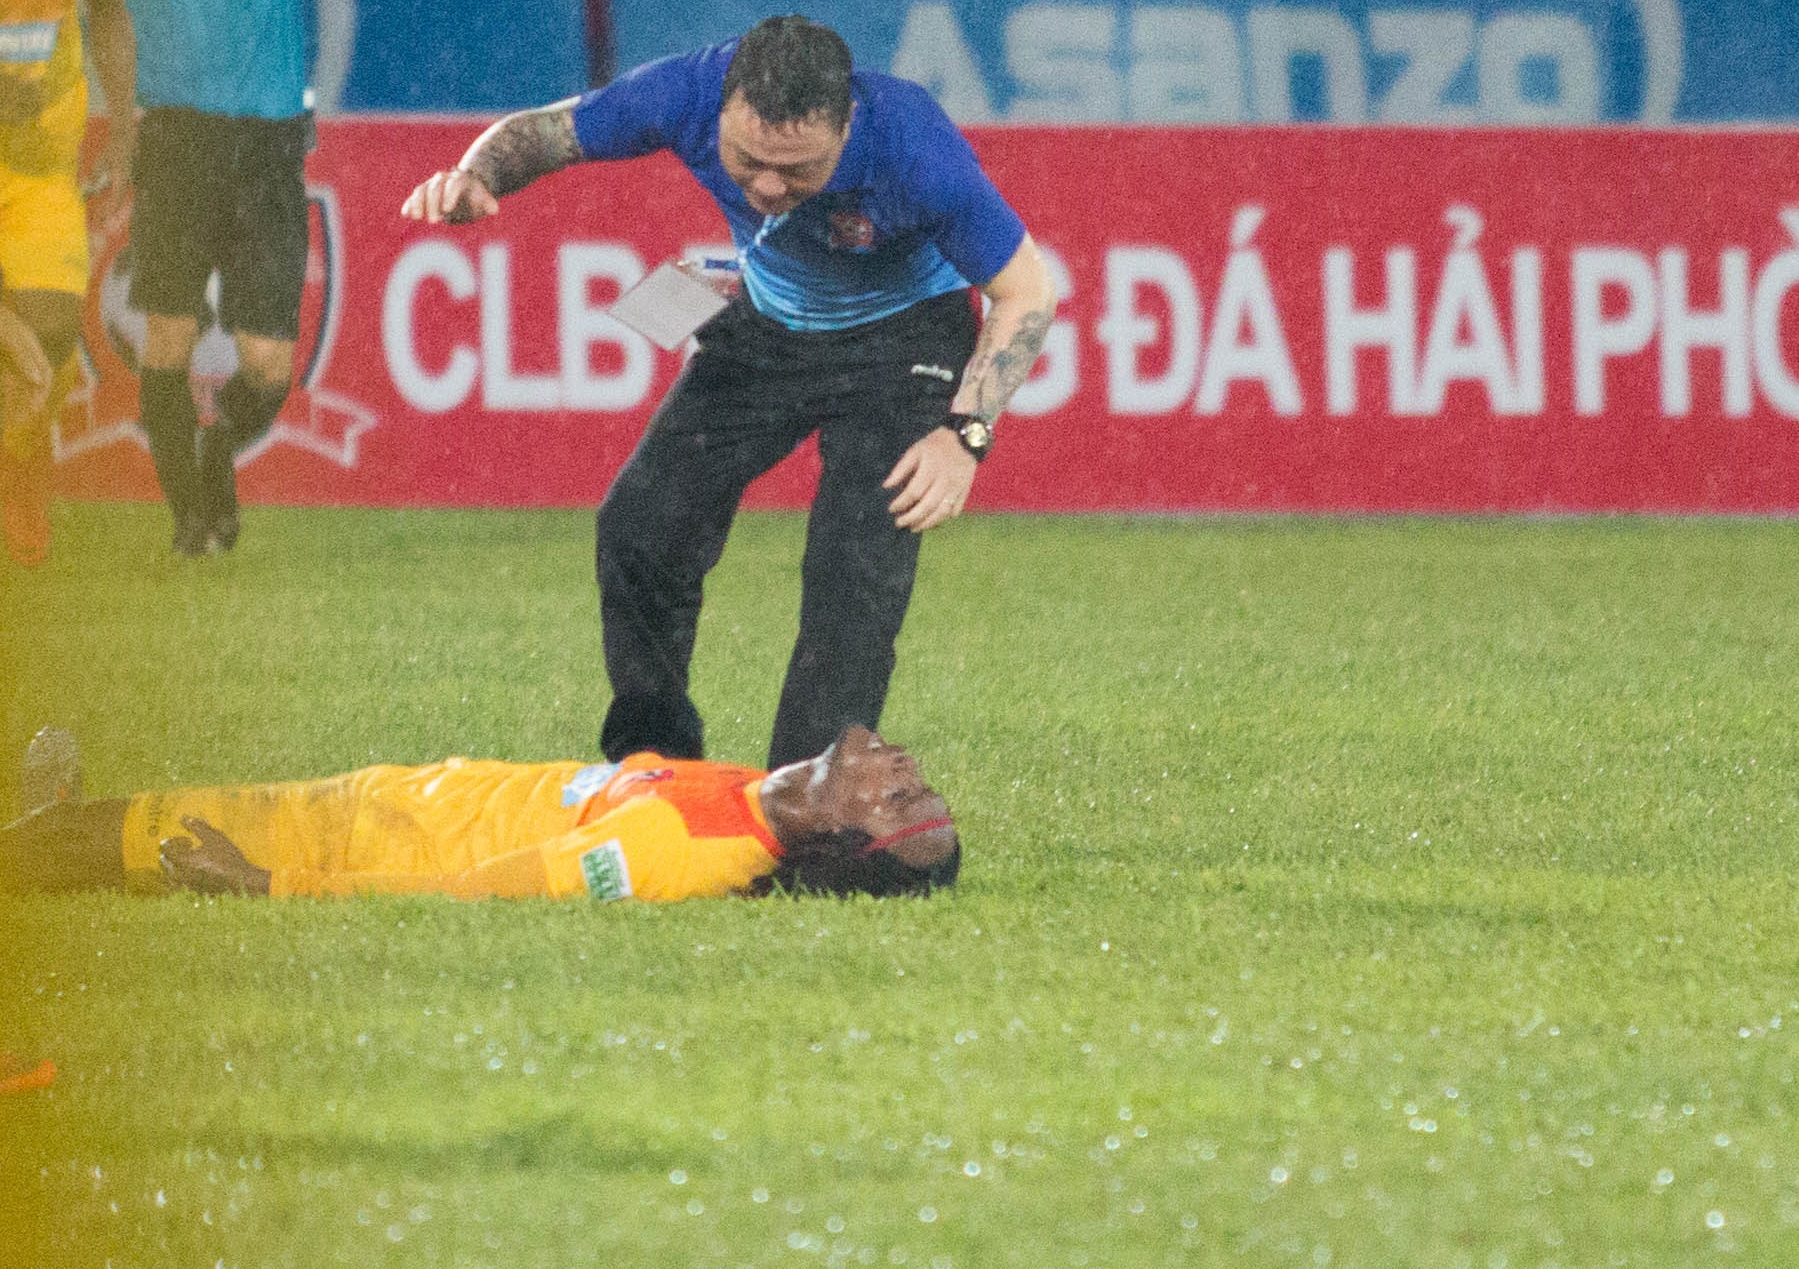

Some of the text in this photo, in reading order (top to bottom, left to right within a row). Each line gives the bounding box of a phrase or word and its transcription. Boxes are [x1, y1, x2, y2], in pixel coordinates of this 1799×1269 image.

[887, 1, 1598, 125] Asanzo
[382, 238, 655, 413] CLB
[1099, 204, 1304, 418] ĐÁ
[1324, 204, 1546, 417] HẢI
